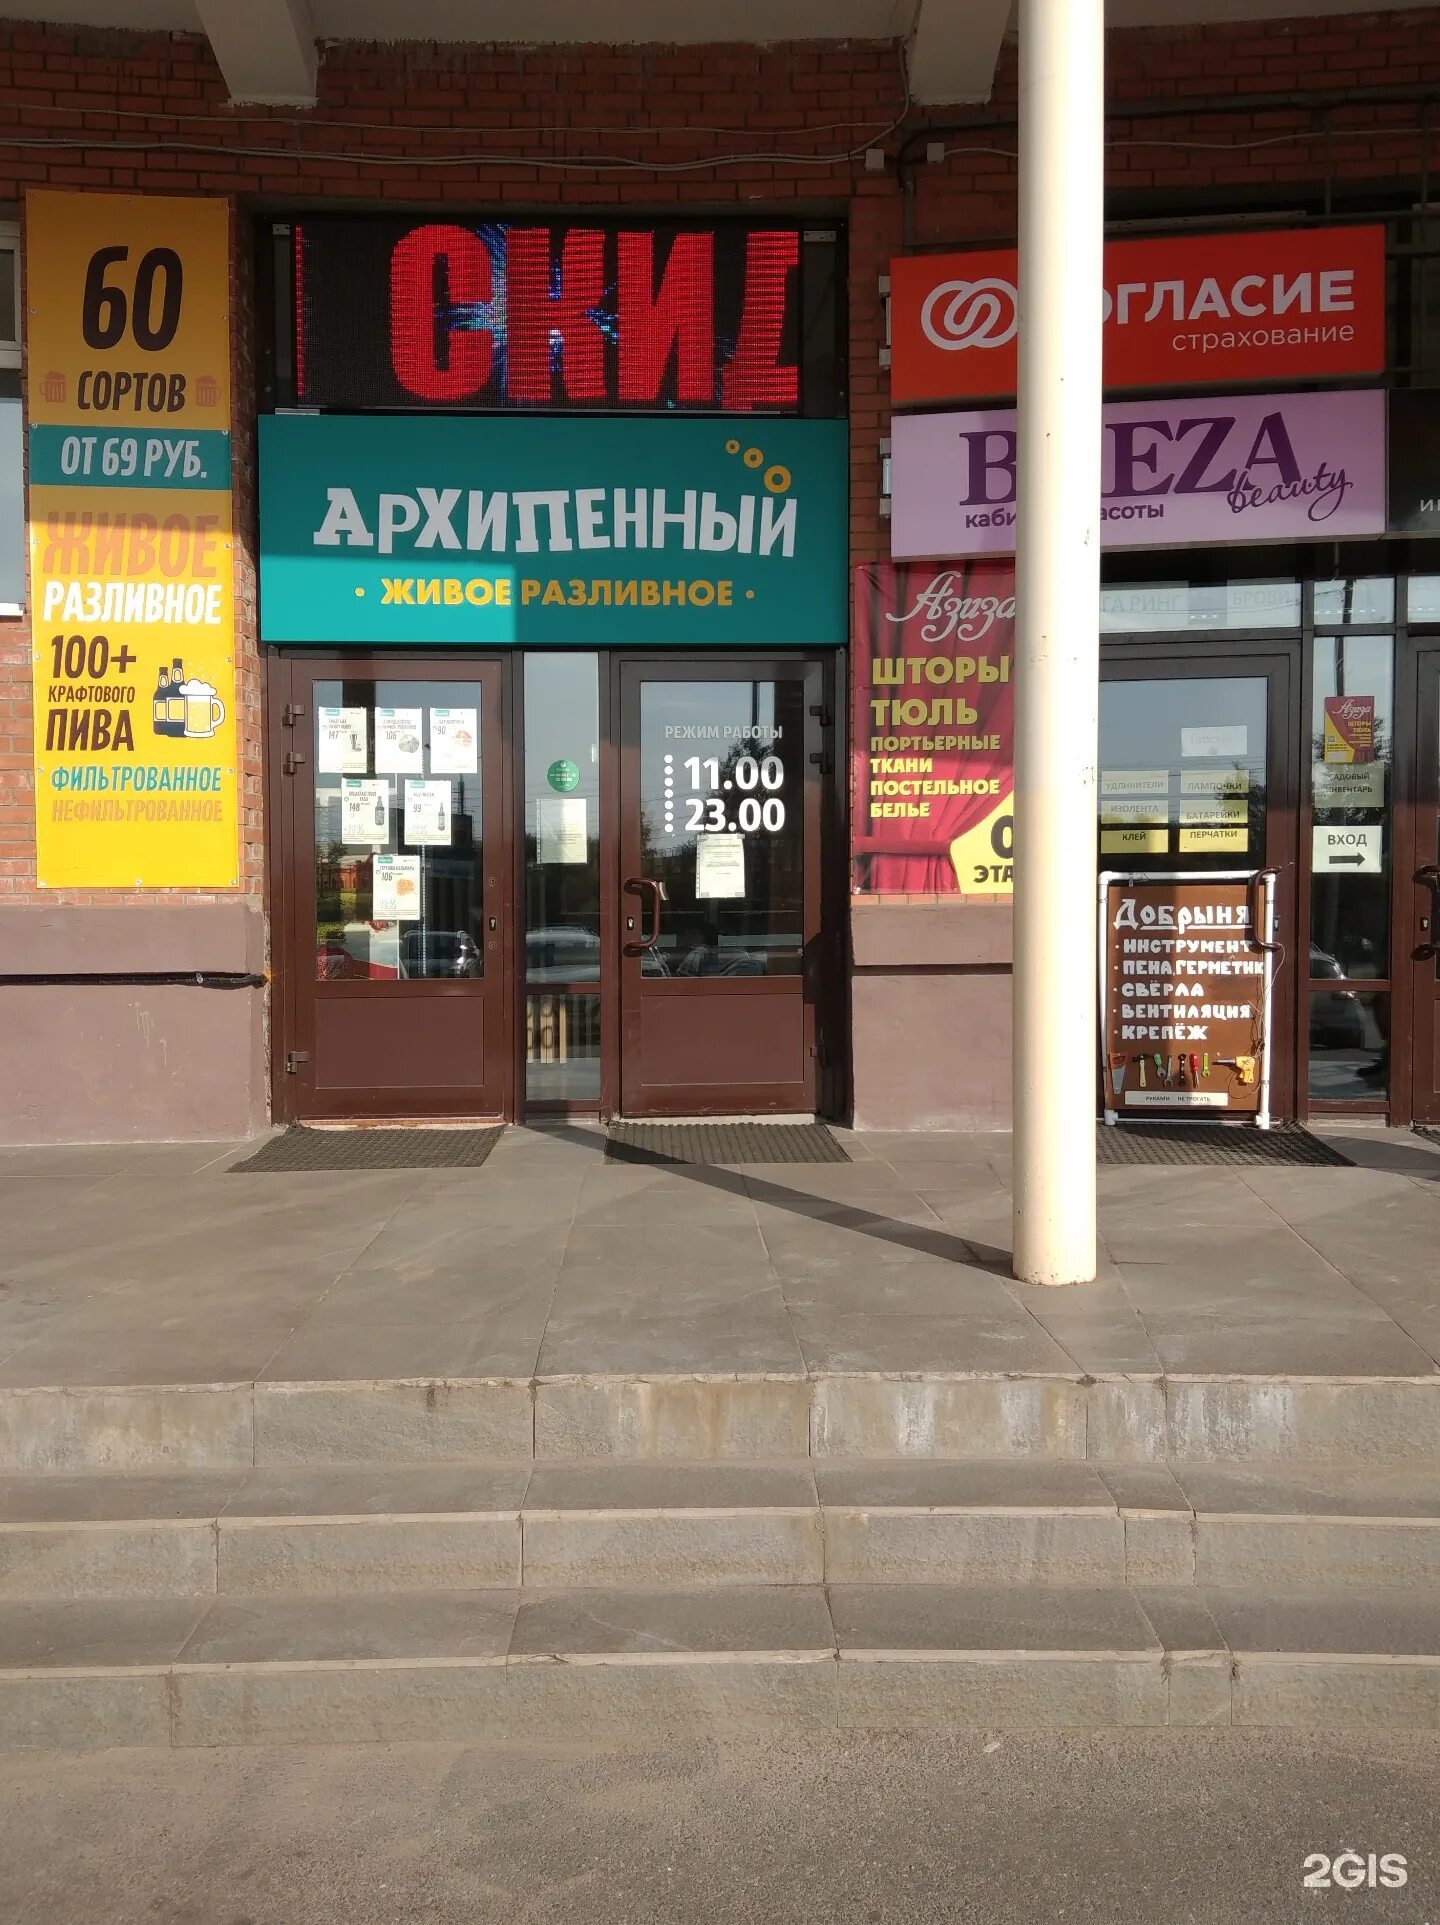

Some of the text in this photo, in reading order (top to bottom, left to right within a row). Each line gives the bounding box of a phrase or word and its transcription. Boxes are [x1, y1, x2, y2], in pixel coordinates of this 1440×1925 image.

[82, 246, 183, 352] 60
[1102, 269, 1354, 325] ГЛАСИЕ
[1172, 323, 1354, 353] страхование
[77, 371, 187, 413] СОРТОВ
[60, 436, 208, 479] ОТ 69 РУБ.
[959, 411, 1302, 506] BEZA
[1227, 462, 1353, 522] beauty
[1100, 504, 1164, 521] соты
[43, 511, 220, 578] ЖИВОЕ
[43, 581, 223, 625] РАЗЛИВНОЕ
[380, 578, 733, 607] ЖИВОЕ РАЗЛИВНОЕ
[51, 635, 137, 679] 100+
[872, 656, 1010, 685] ШТОРЫ
[48, 685, 136, 704] КРАФТОВОГО
[870, 698, 978, 726] ТЮЛЬ
[45, 708, 135, 752] ПИВА
[664, 725, 783, 740] РЕЖИМ РАБОТЫ
[870, 735, 1001, 752] ПОРТЬЕРНЫЕ
[683, 756, 784, 790] 11.00
[870, 758, 933, 774] ТКАНИ
[51, 765, 222, 792] ФИЛЬТРОВАННОЕ
[870, 779, 1001, 796] ПОСТЕЛЬНОЕ
[1105, 781, 1164, 791] УДЛИНИТЕЛИ
[1187, 781, 1242, 791] ЛАМПОЧКИ
[51, 798, 223, 823] НЕФИЛЬТРОВАННОЕ
[684, 798, 786, 832] 23.00
[870, 802, 932, 818] БЕЛЬЕ
[1110, 804, 1159, 814] ИЗОЛЕНТА
[1186, 809, 1241, 821] БАТАРЕЙКИ
[1122, 830, 1147, 842] КЛЕЙ
[1189, 829, 1238, 840] ПЕРЧАТКИ
[1327, 833, 1368, 848] ВХОД
[972, 864, 1014, 883] ЭТА
[1123, 938, 1253, 954] ИНСТРУМЕНТ
[1121, 1004, 1251, 1021] ВЕНТИЛЯЦИЯ
[1121, 1022, 1208, 1040] КРЕПЁЖ
